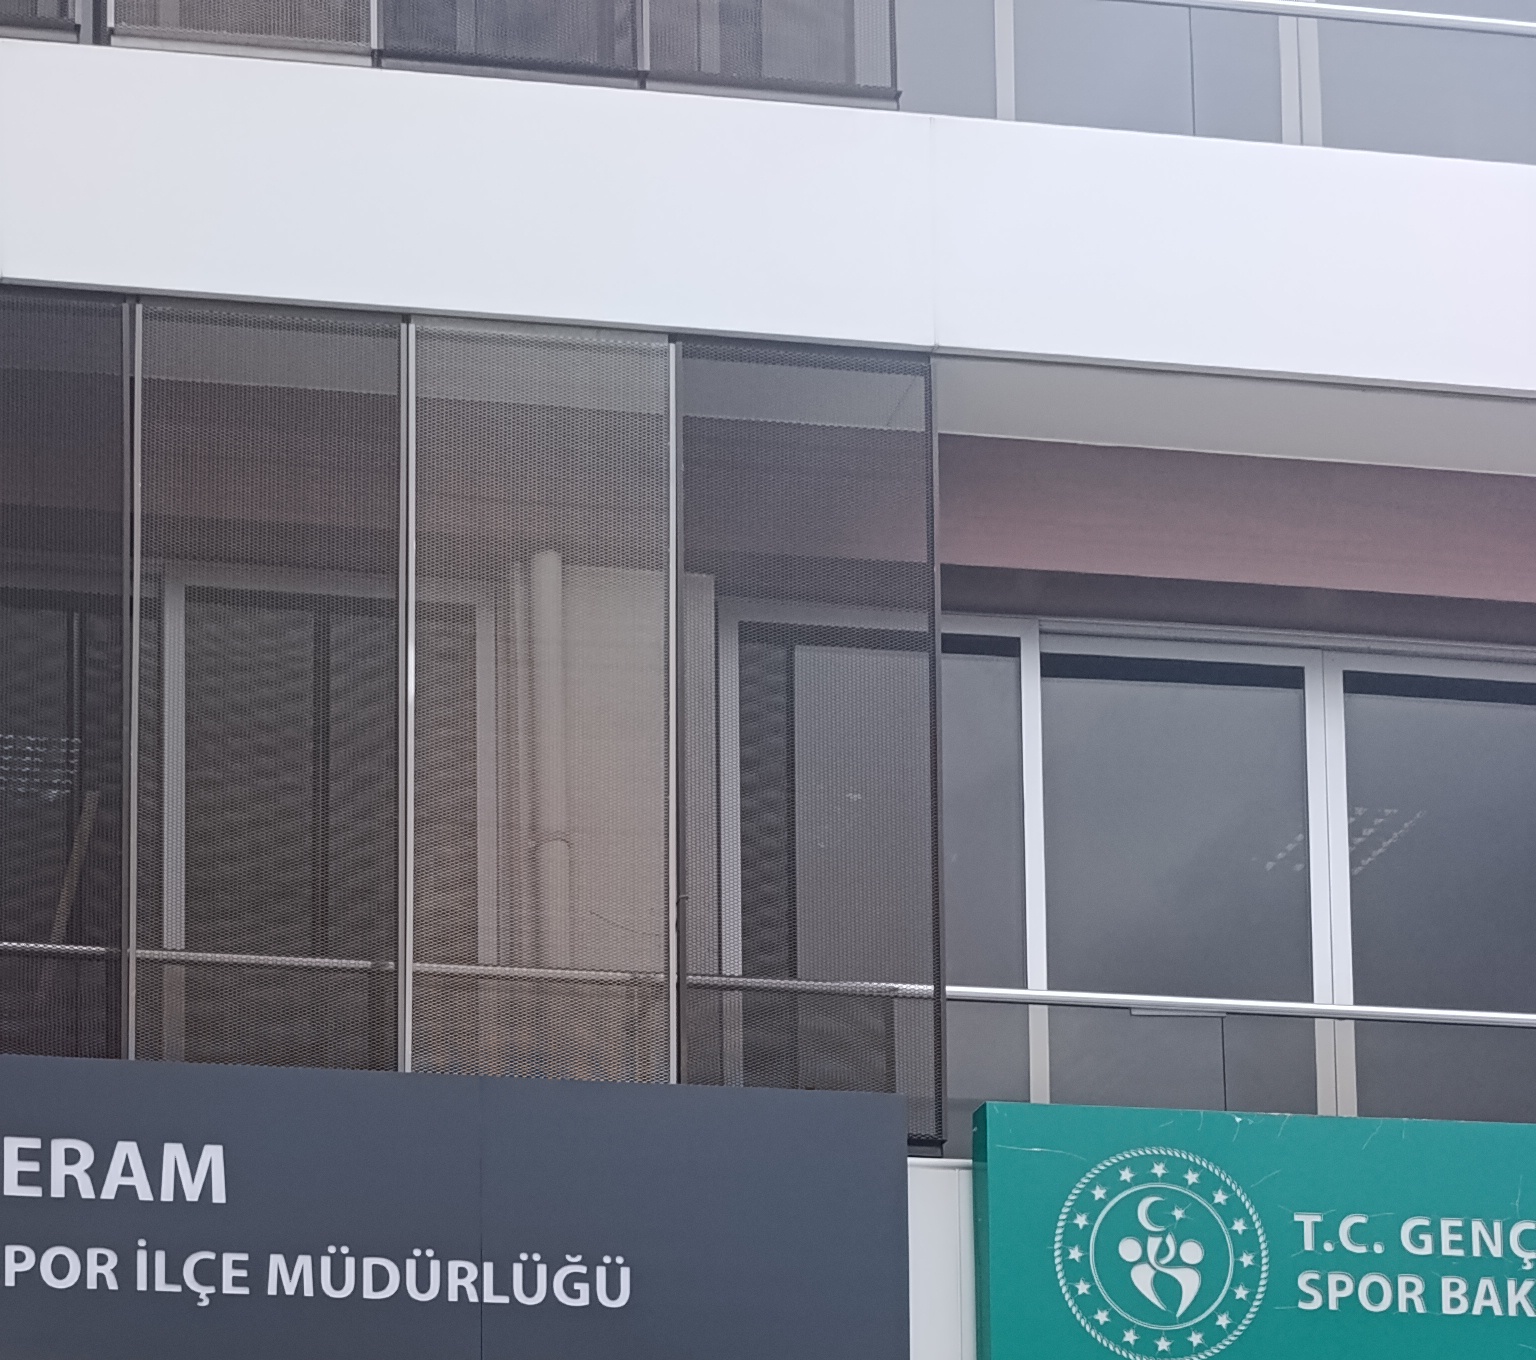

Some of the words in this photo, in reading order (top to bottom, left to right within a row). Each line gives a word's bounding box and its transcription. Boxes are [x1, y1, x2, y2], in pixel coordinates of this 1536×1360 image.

[1293, 1212, 1384, 1254] T.C.
[136, 1238, 250, 1307] İLÇE
[267, 1245, 631, 1308] MÜDÜRLÜĞÜ
[1297, 1270, 1427, 1314] SPOR
